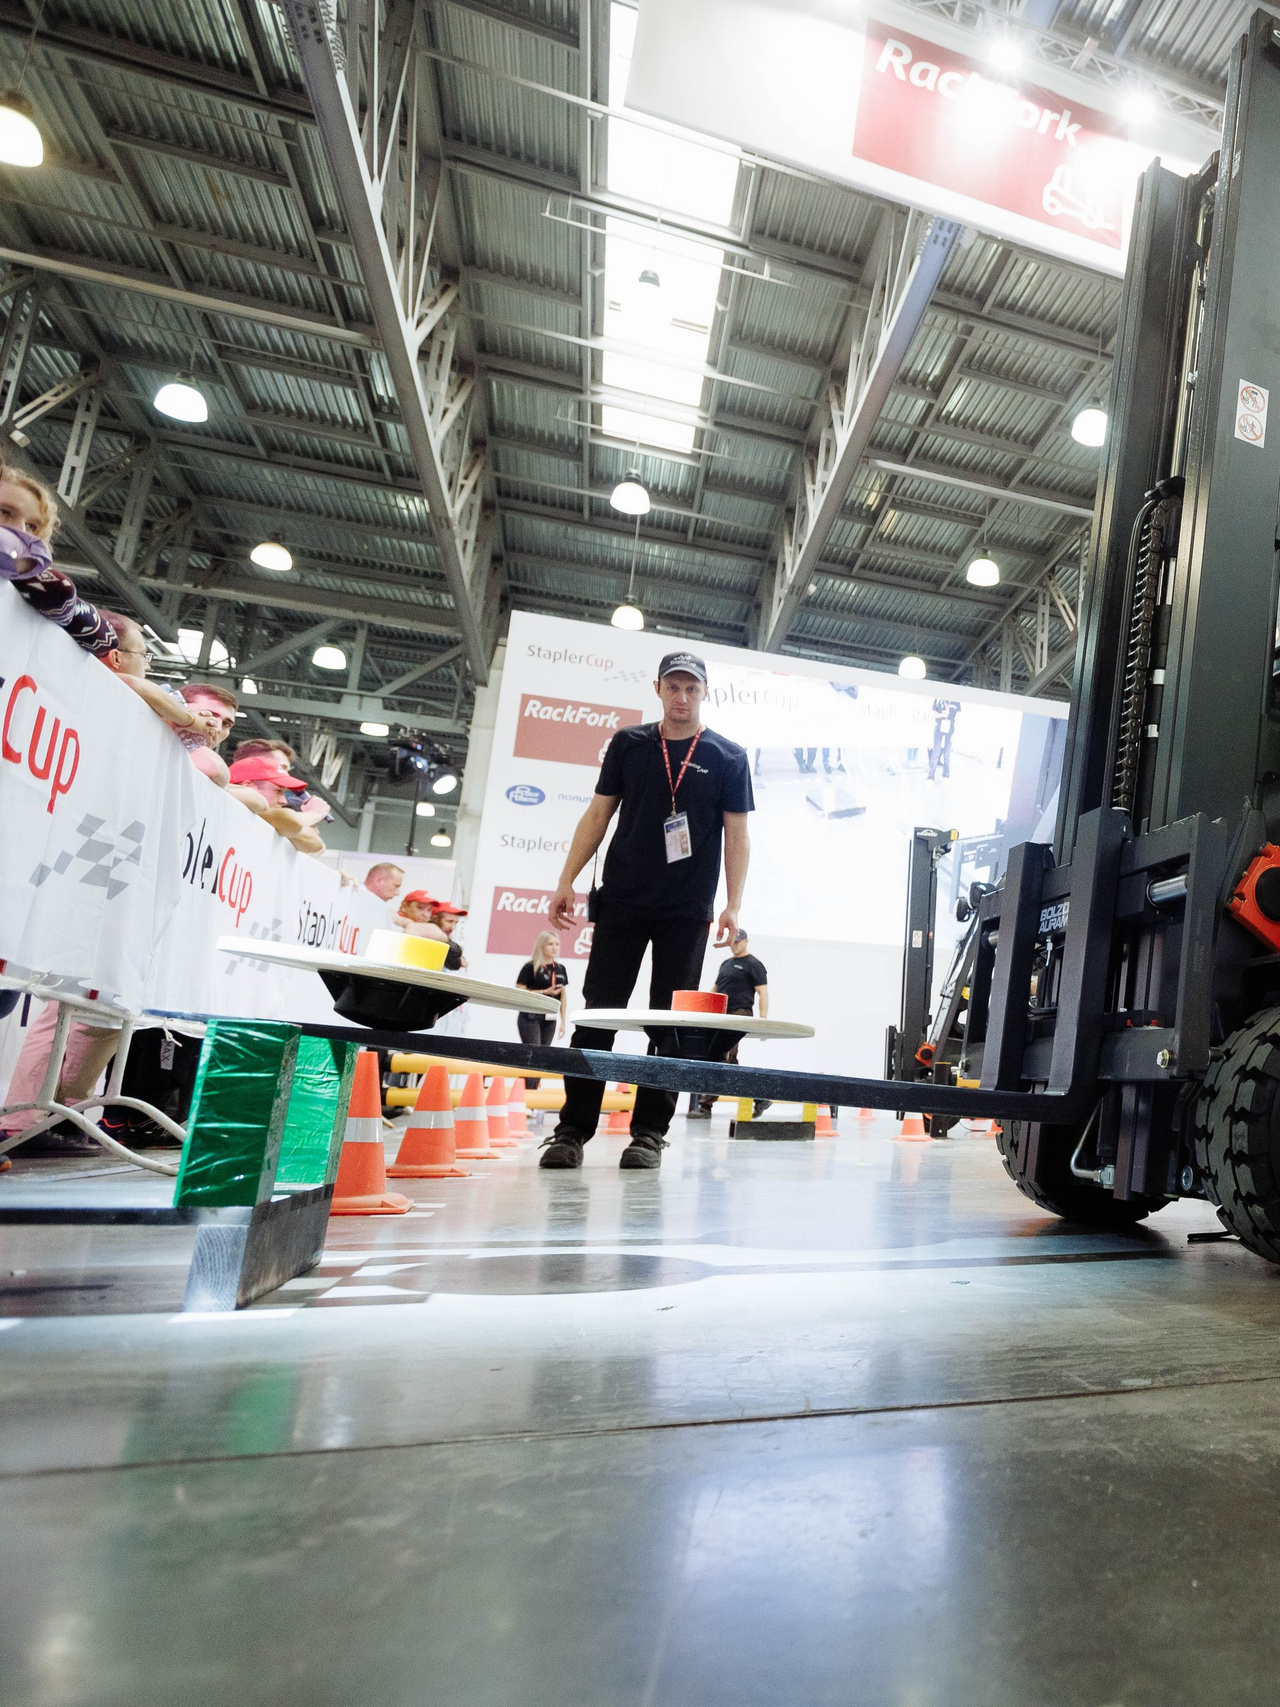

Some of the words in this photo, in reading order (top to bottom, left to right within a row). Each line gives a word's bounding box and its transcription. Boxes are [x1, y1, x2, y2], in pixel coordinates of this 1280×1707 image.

[527, 644, 614, 671] StaplerCup
[524, 699, 620, 729] RackFork
[0, 675, 80, 814] Cup
